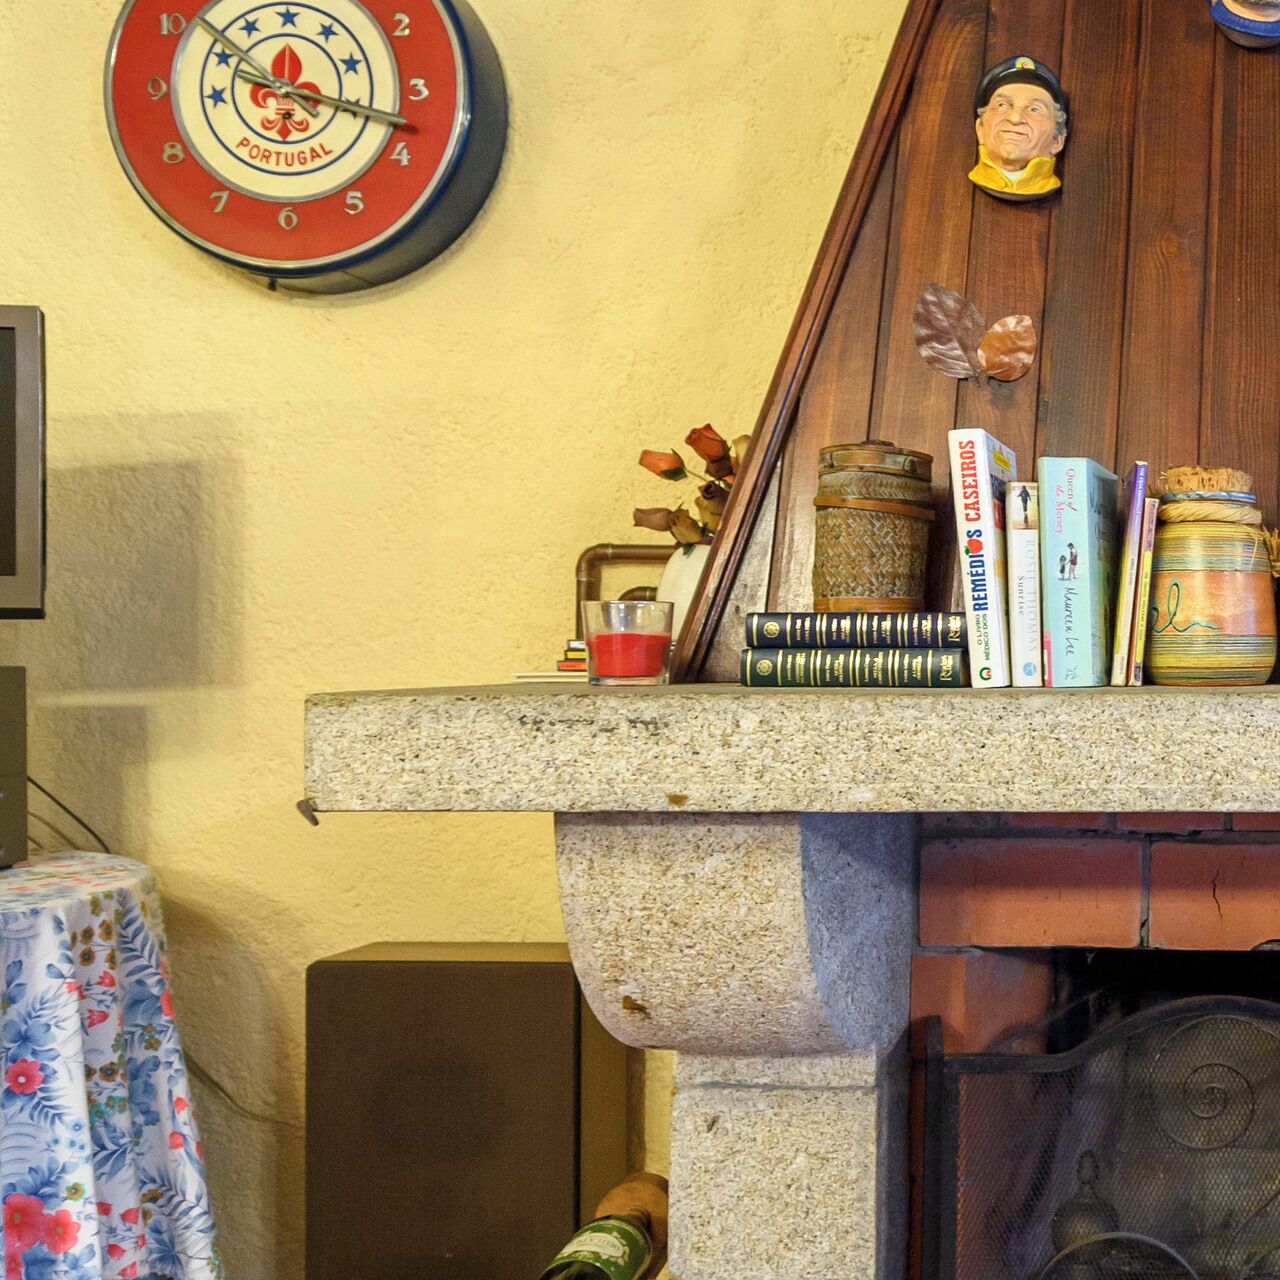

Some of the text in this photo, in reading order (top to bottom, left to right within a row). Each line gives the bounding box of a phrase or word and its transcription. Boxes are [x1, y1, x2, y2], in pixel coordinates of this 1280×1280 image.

[159, 12, 187, 35] 10
[393, 13, 411, 36] 2
[147, 77, 168, 100] 9
[408, 78, 430, 100] 3
[162, 141, 185, 164] 8
[235, 136, 334, 167] PORTUGAL
[390, 142, 411, 166] 4
[209, 190, 230, 213] 7
[344, 191, 364, 215] 5
[277, 206, 299, 231] 6
[959, 439, 981, 522] CASEIROS
[1065, 469, 1076, 500] Queen
[974, 613, 982, 635] LIVRO
[1026, 591, 1038, 653] THOMAS
[1064, 587, 1079, 656] Maureen Lee
[982, 631, 990, 661] MÉDICO
